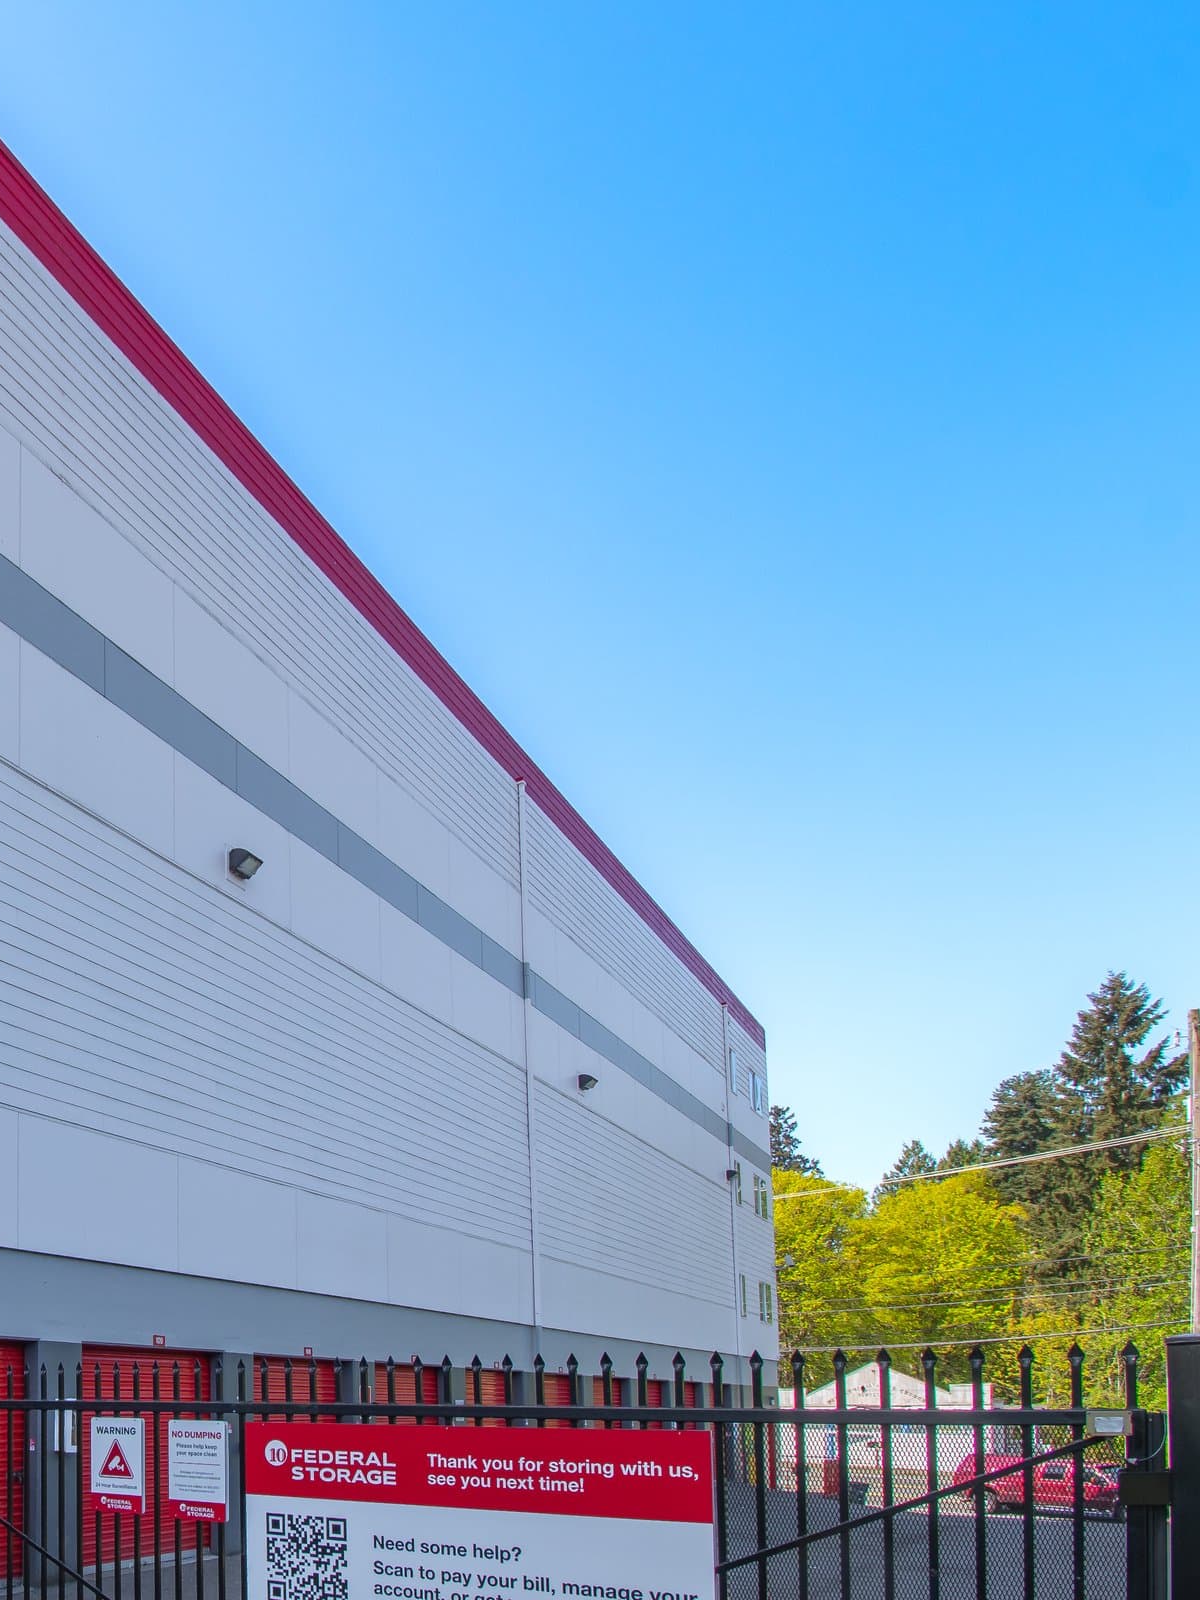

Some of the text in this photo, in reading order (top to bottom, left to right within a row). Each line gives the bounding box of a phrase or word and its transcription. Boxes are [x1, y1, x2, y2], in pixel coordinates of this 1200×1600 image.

[96, 1425, 137, 1436] WARNING
[184, 1431, 222, 1440] DUMPING
[290, 1448, 397, 1467] FEDERAL
[426, 1453, 699, 1481] Thank you for storing with us,
[291, 1466, 397, 1486] STORAGE
[427, 1473, 585, 1493] see you next time!
[186, 1505, 215, 1513] FEDERAL
[373, 1535, 522, 1563] Need some help?
[373, 1560, 414, 1578] Scan
[418, 1565, 436, 1581] to
[441, 1570, 472, 1587] pay
[477, 1573, 518, 1589] your
[523, 1575, 556, 1596] bill,
[562, 1581, 643, 1600] manage
